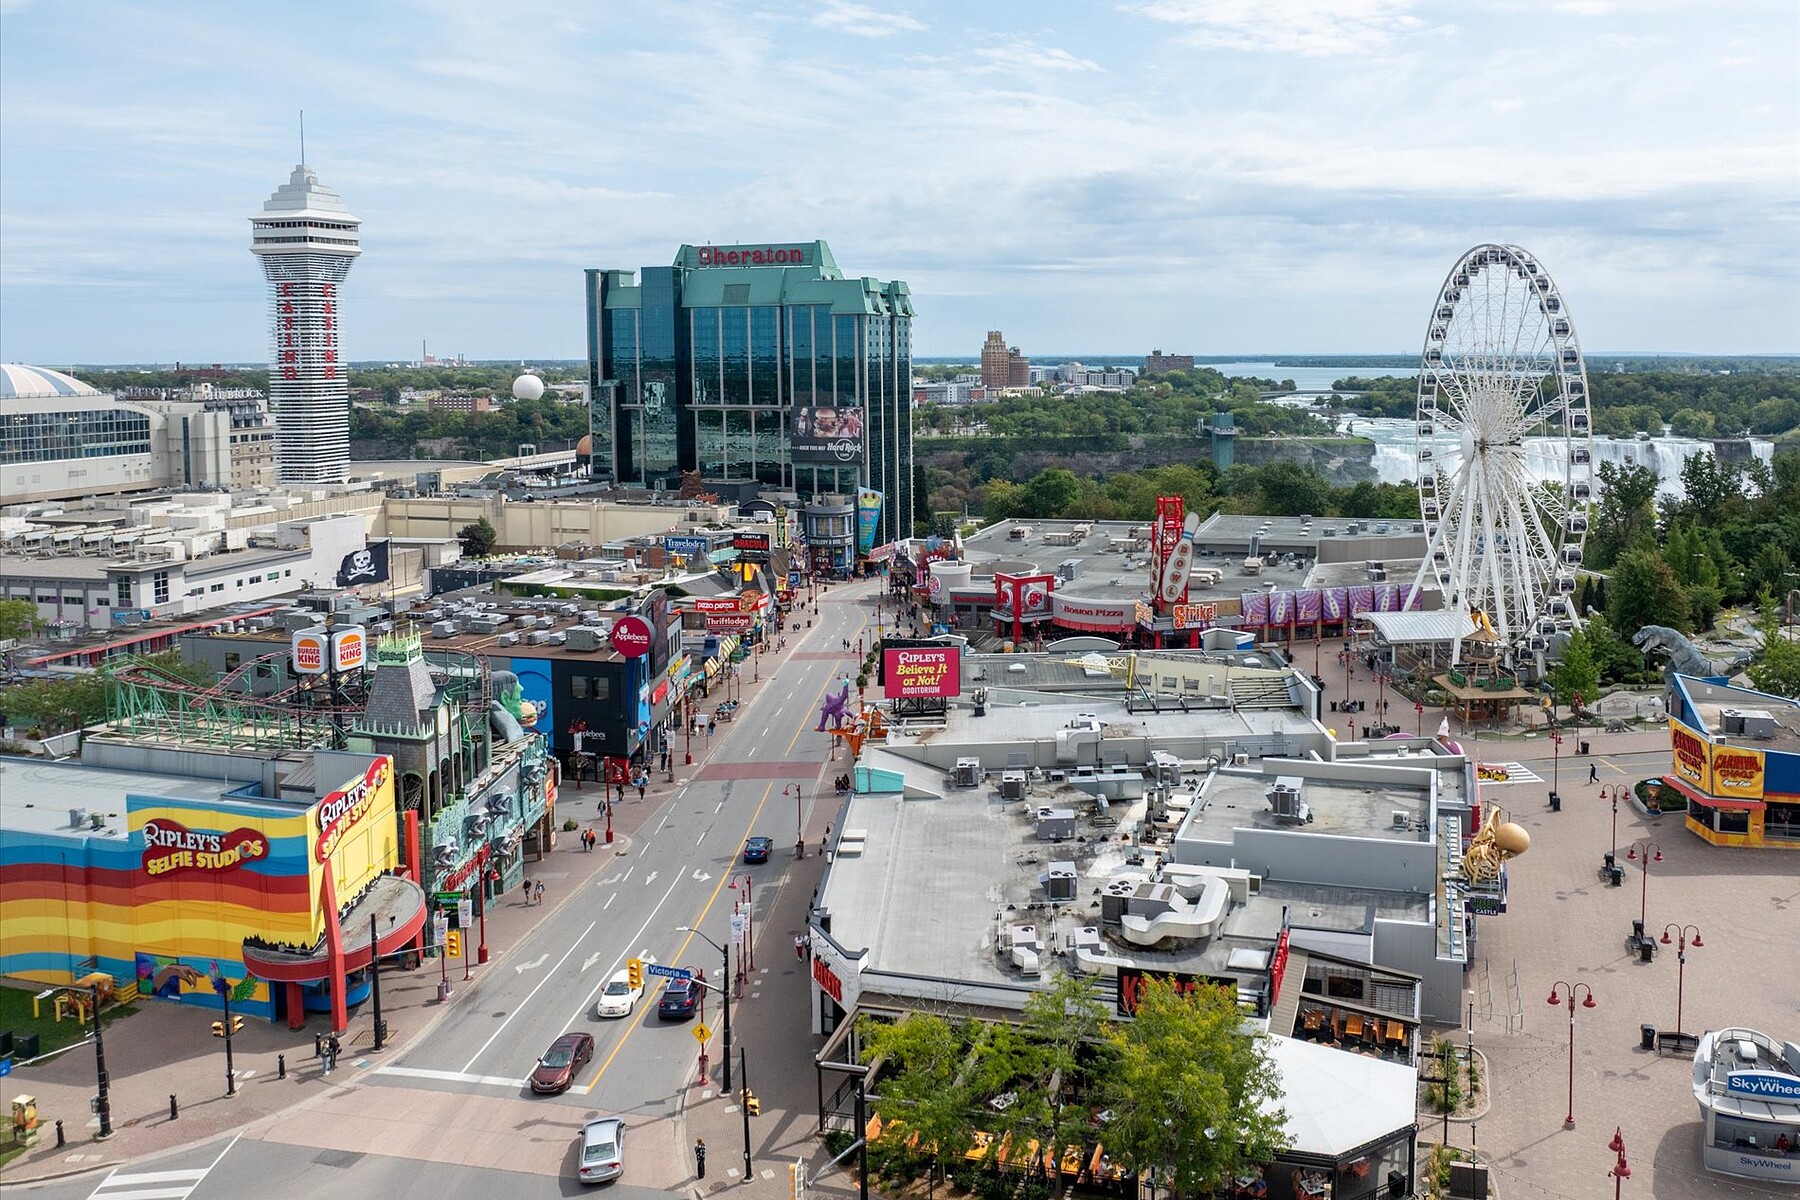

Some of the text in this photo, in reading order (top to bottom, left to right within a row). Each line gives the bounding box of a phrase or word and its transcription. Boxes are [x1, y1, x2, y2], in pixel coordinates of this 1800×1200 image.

[699, 246, 803, 265] Sheraton
[282, 283, 297, 381] CASINO
[323, 283, 336, 380] CASINO
[228, 388, 263, 399] BROCK
[827, 443, 862, 453] Hard Rock
[697, 602, 735, 611] pizza pizza
[1063, 605, 1124, 617] Boston Pizza
[707, 617, 749, 627] Thriftlodge
[298, 647, 320, 655] BURGER
[340, 641, 362, 652] BURGER
[298, 654, 320, 664] KING
[340, 648, 362, 662] KING
[898, 651, 946, 664] RIPLEY'S
[896, 663, 948, 675] Believe It
[903, 675, 940, 686] or Not!
[902, 686, 940, 694] ODDITORIUM
[1714, 754, 1763, 772] CARNIVAL
[1718, 769, 1755, 779] CHAOS
[320, 780, 367, 832] RIPLEY'S
[142, 822, 222, 852] RIPLEY'S
[147, 840, 263, 875] SELFIE STUDIOS
[1475, 908, 1498, 916] CASTLE
[650, 965, 680, 977] Victoria
[1731, 1077, 1800, 1094] SkyWhee
[1739, 1156, 1792, 1170] SkyWheel
